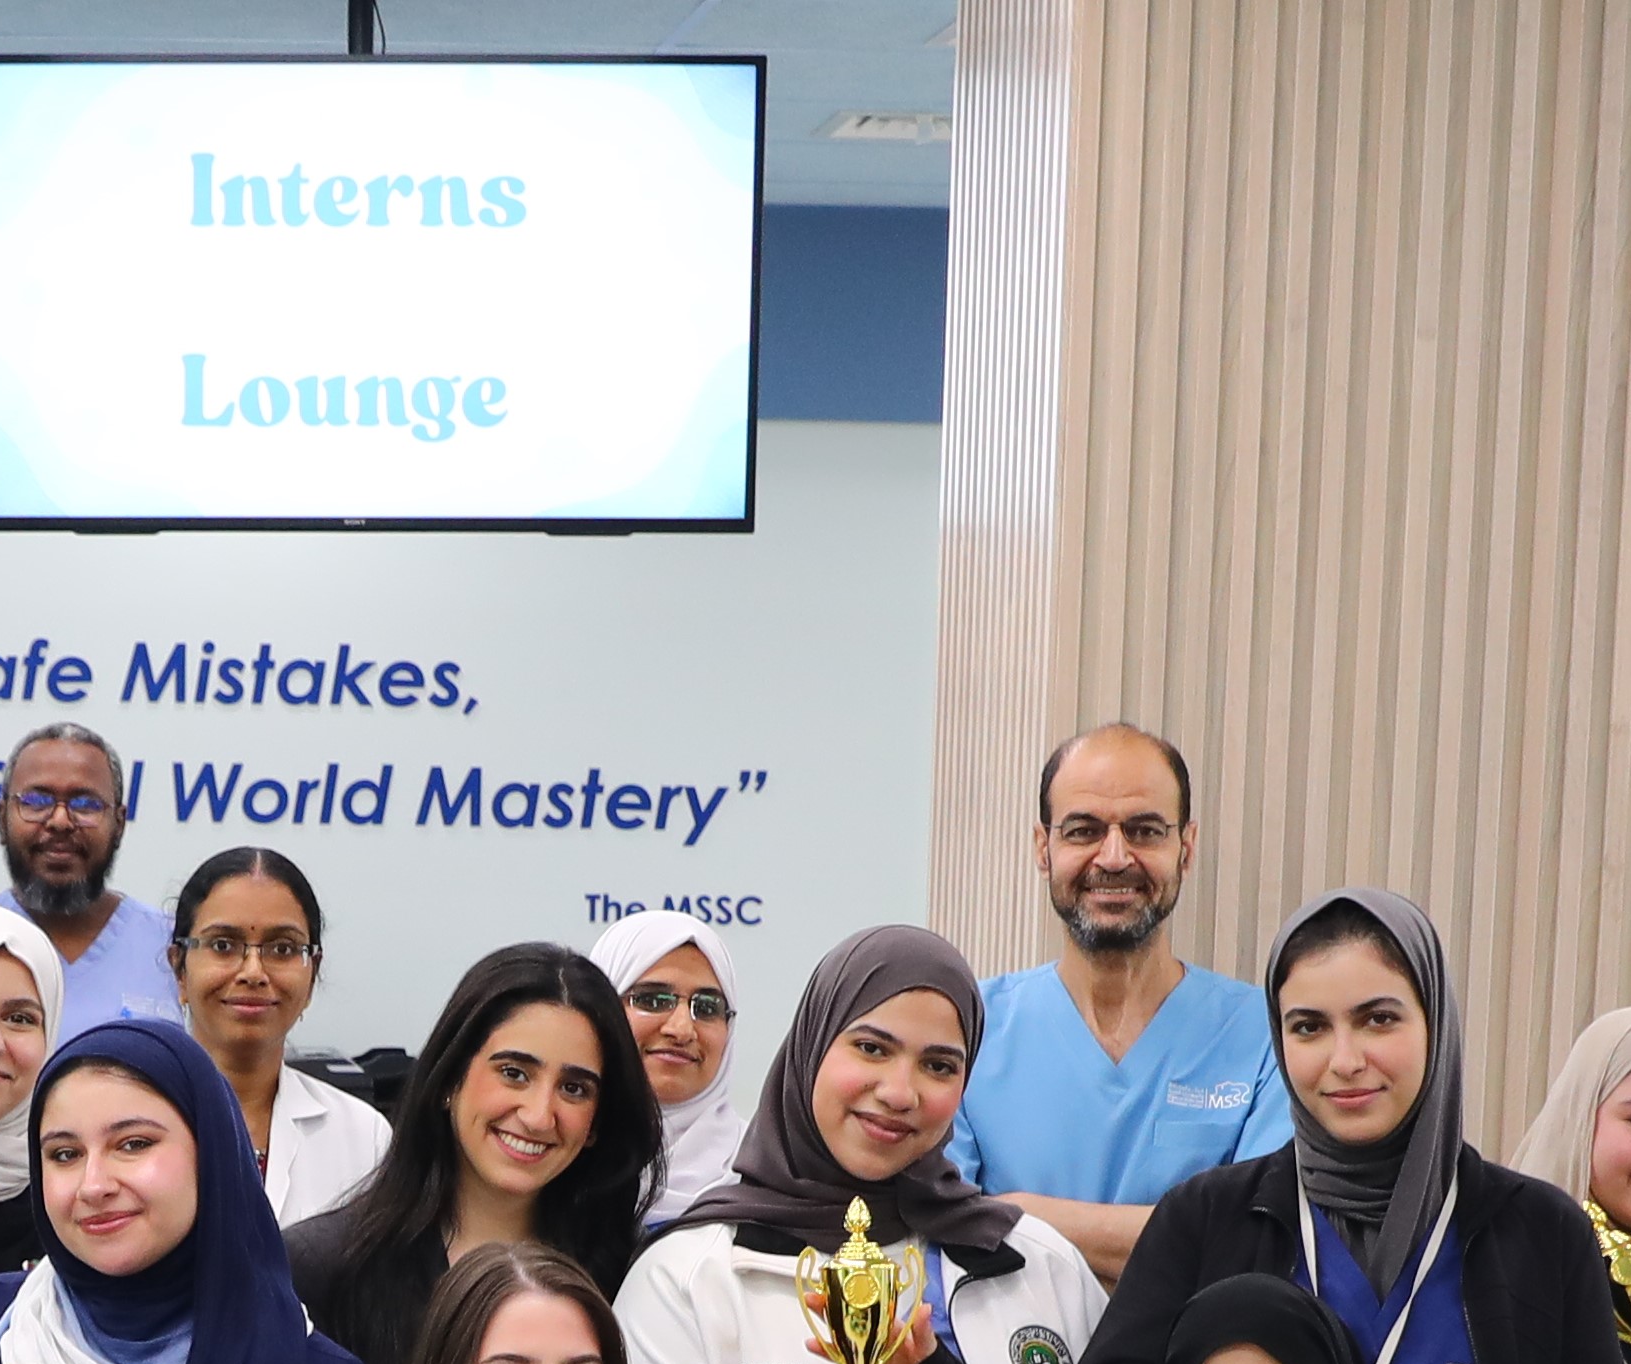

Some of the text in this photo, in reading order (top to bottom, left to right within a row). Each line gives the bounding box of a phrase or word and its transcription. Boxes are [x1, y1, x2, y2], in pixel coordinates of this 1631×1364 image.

[190, 152, 527, 228] Interns
[181, 353, 507, 443] Lounge
[122, 641, 478, 715] Mistakes,
[173, 762, 395, 826] World
[417, 766, 769, 847] Mastery”
[584, 893, 647, 922] The
[1208, 1088, 1252, 1110] MSSC
